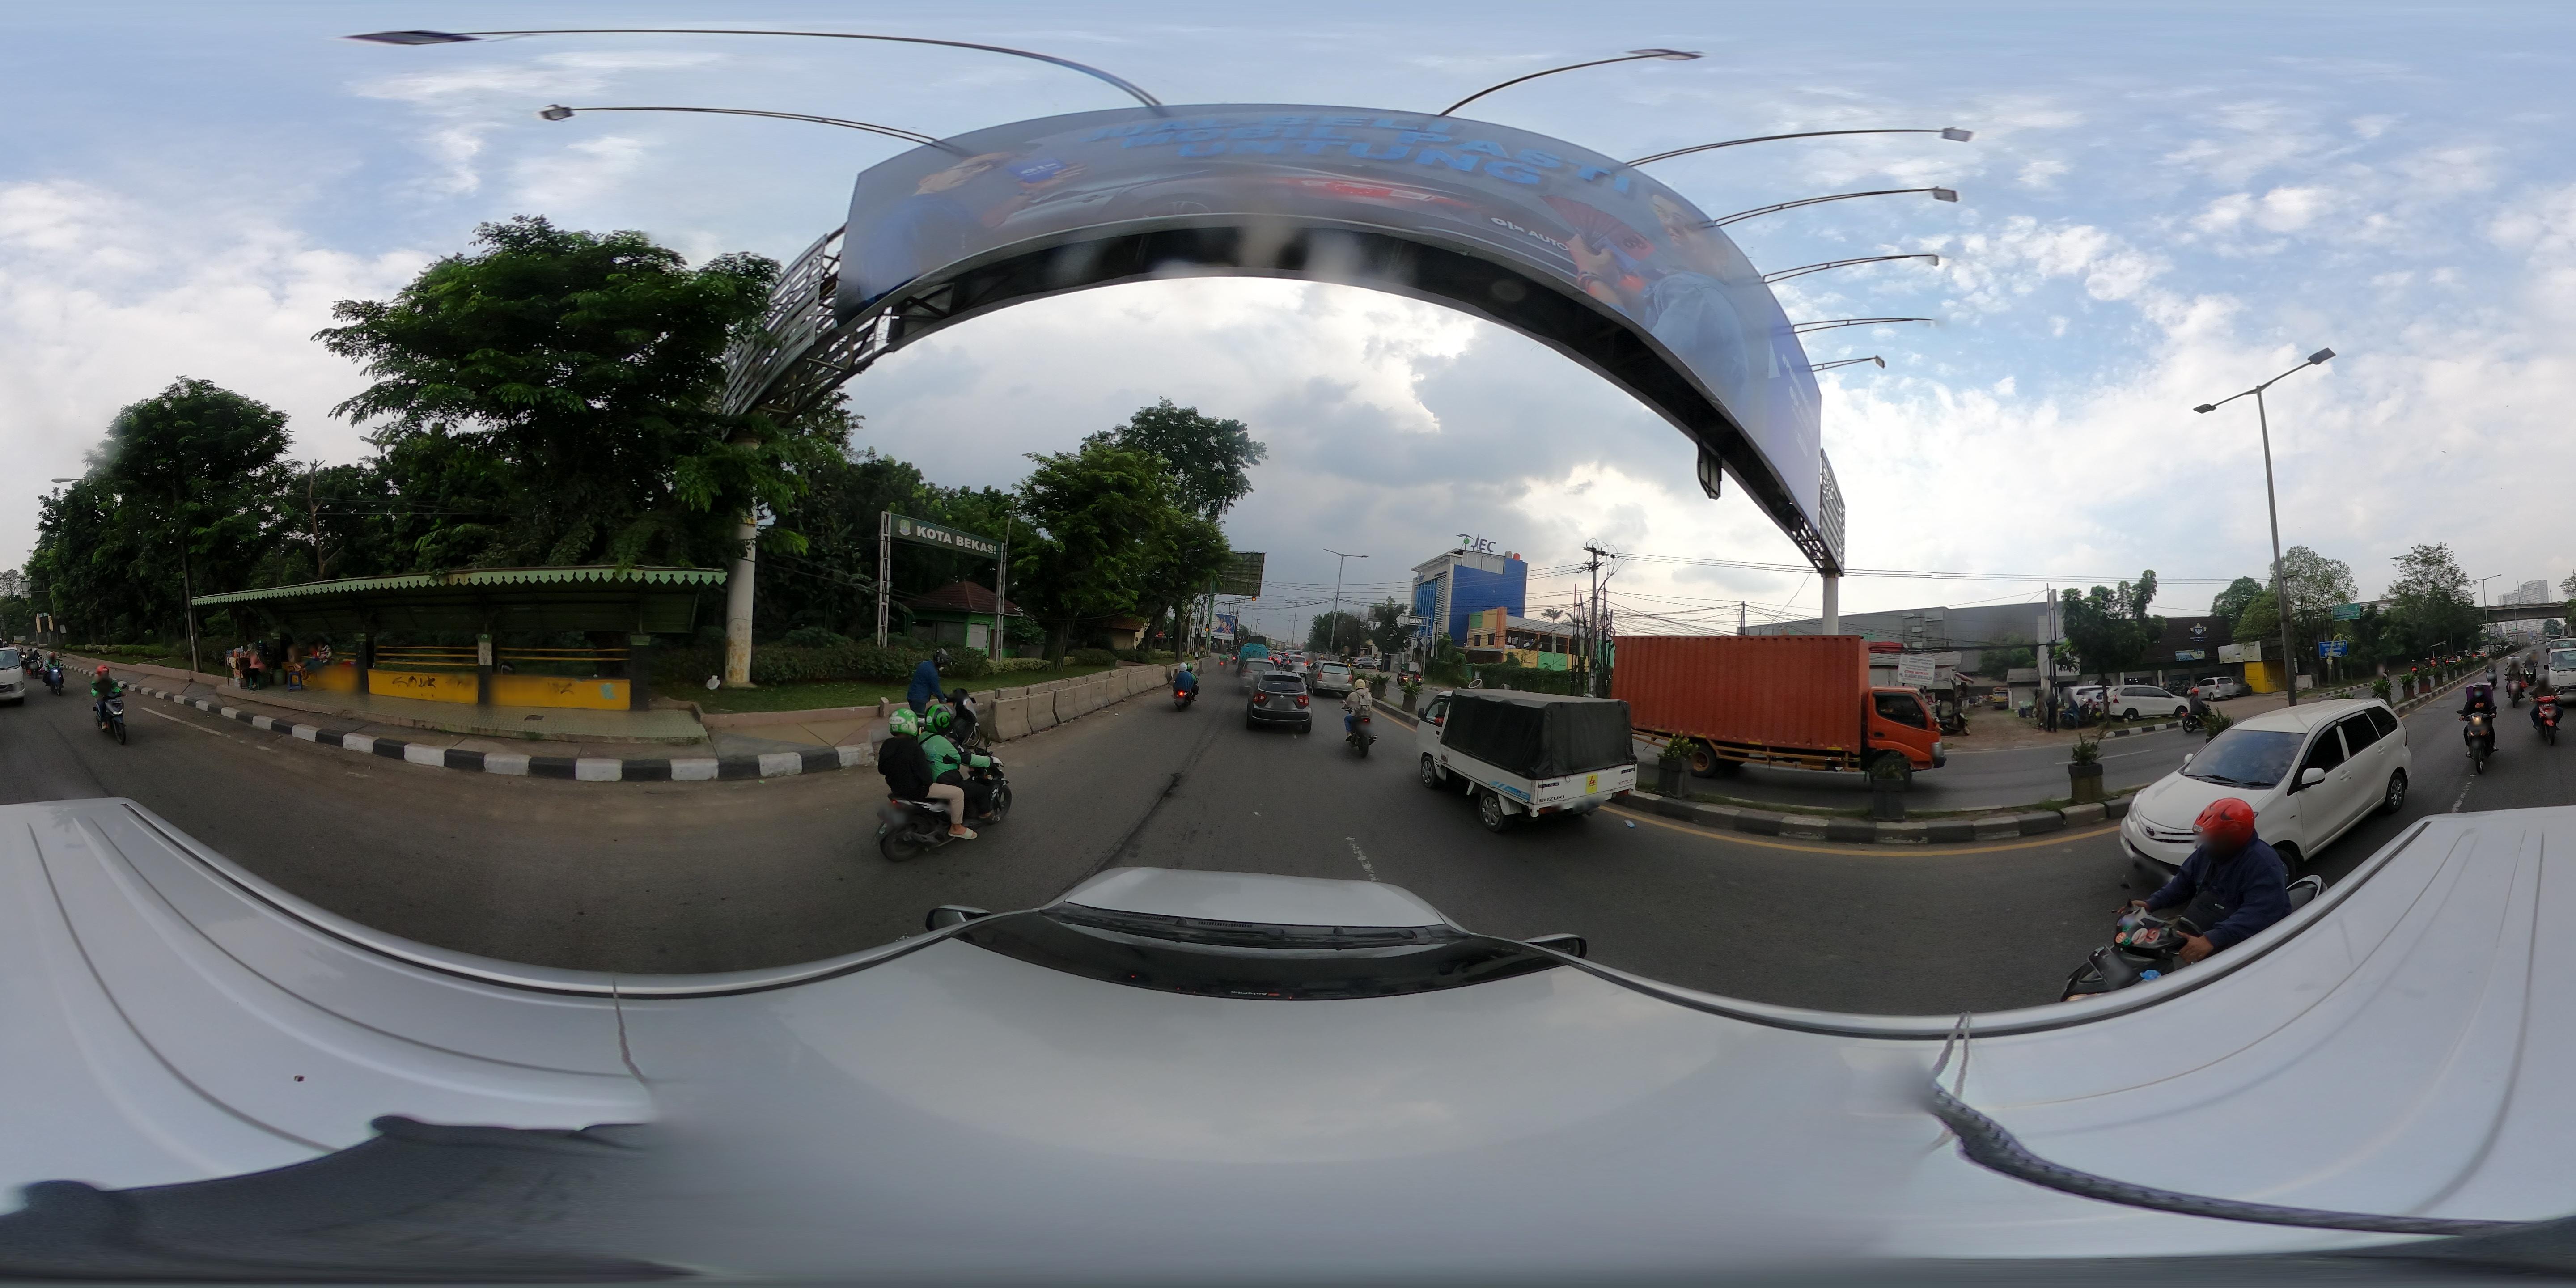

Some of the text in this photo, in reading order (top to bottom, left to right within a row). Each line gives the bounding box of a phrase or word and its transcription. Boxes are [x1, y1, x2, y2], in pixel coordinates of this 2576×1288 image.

[1122, 126, 1631, 194] MOBIL PASTI
[1178, 140, 1542, 185] UNTUNG
[1528, 230, 1569, 251] AUTO
[917, 525, 997, 555] KOTA BEKASI
[1470, 538, 1496, 552] JEC
[1539, 795, 1565, 803] SUZUKI
